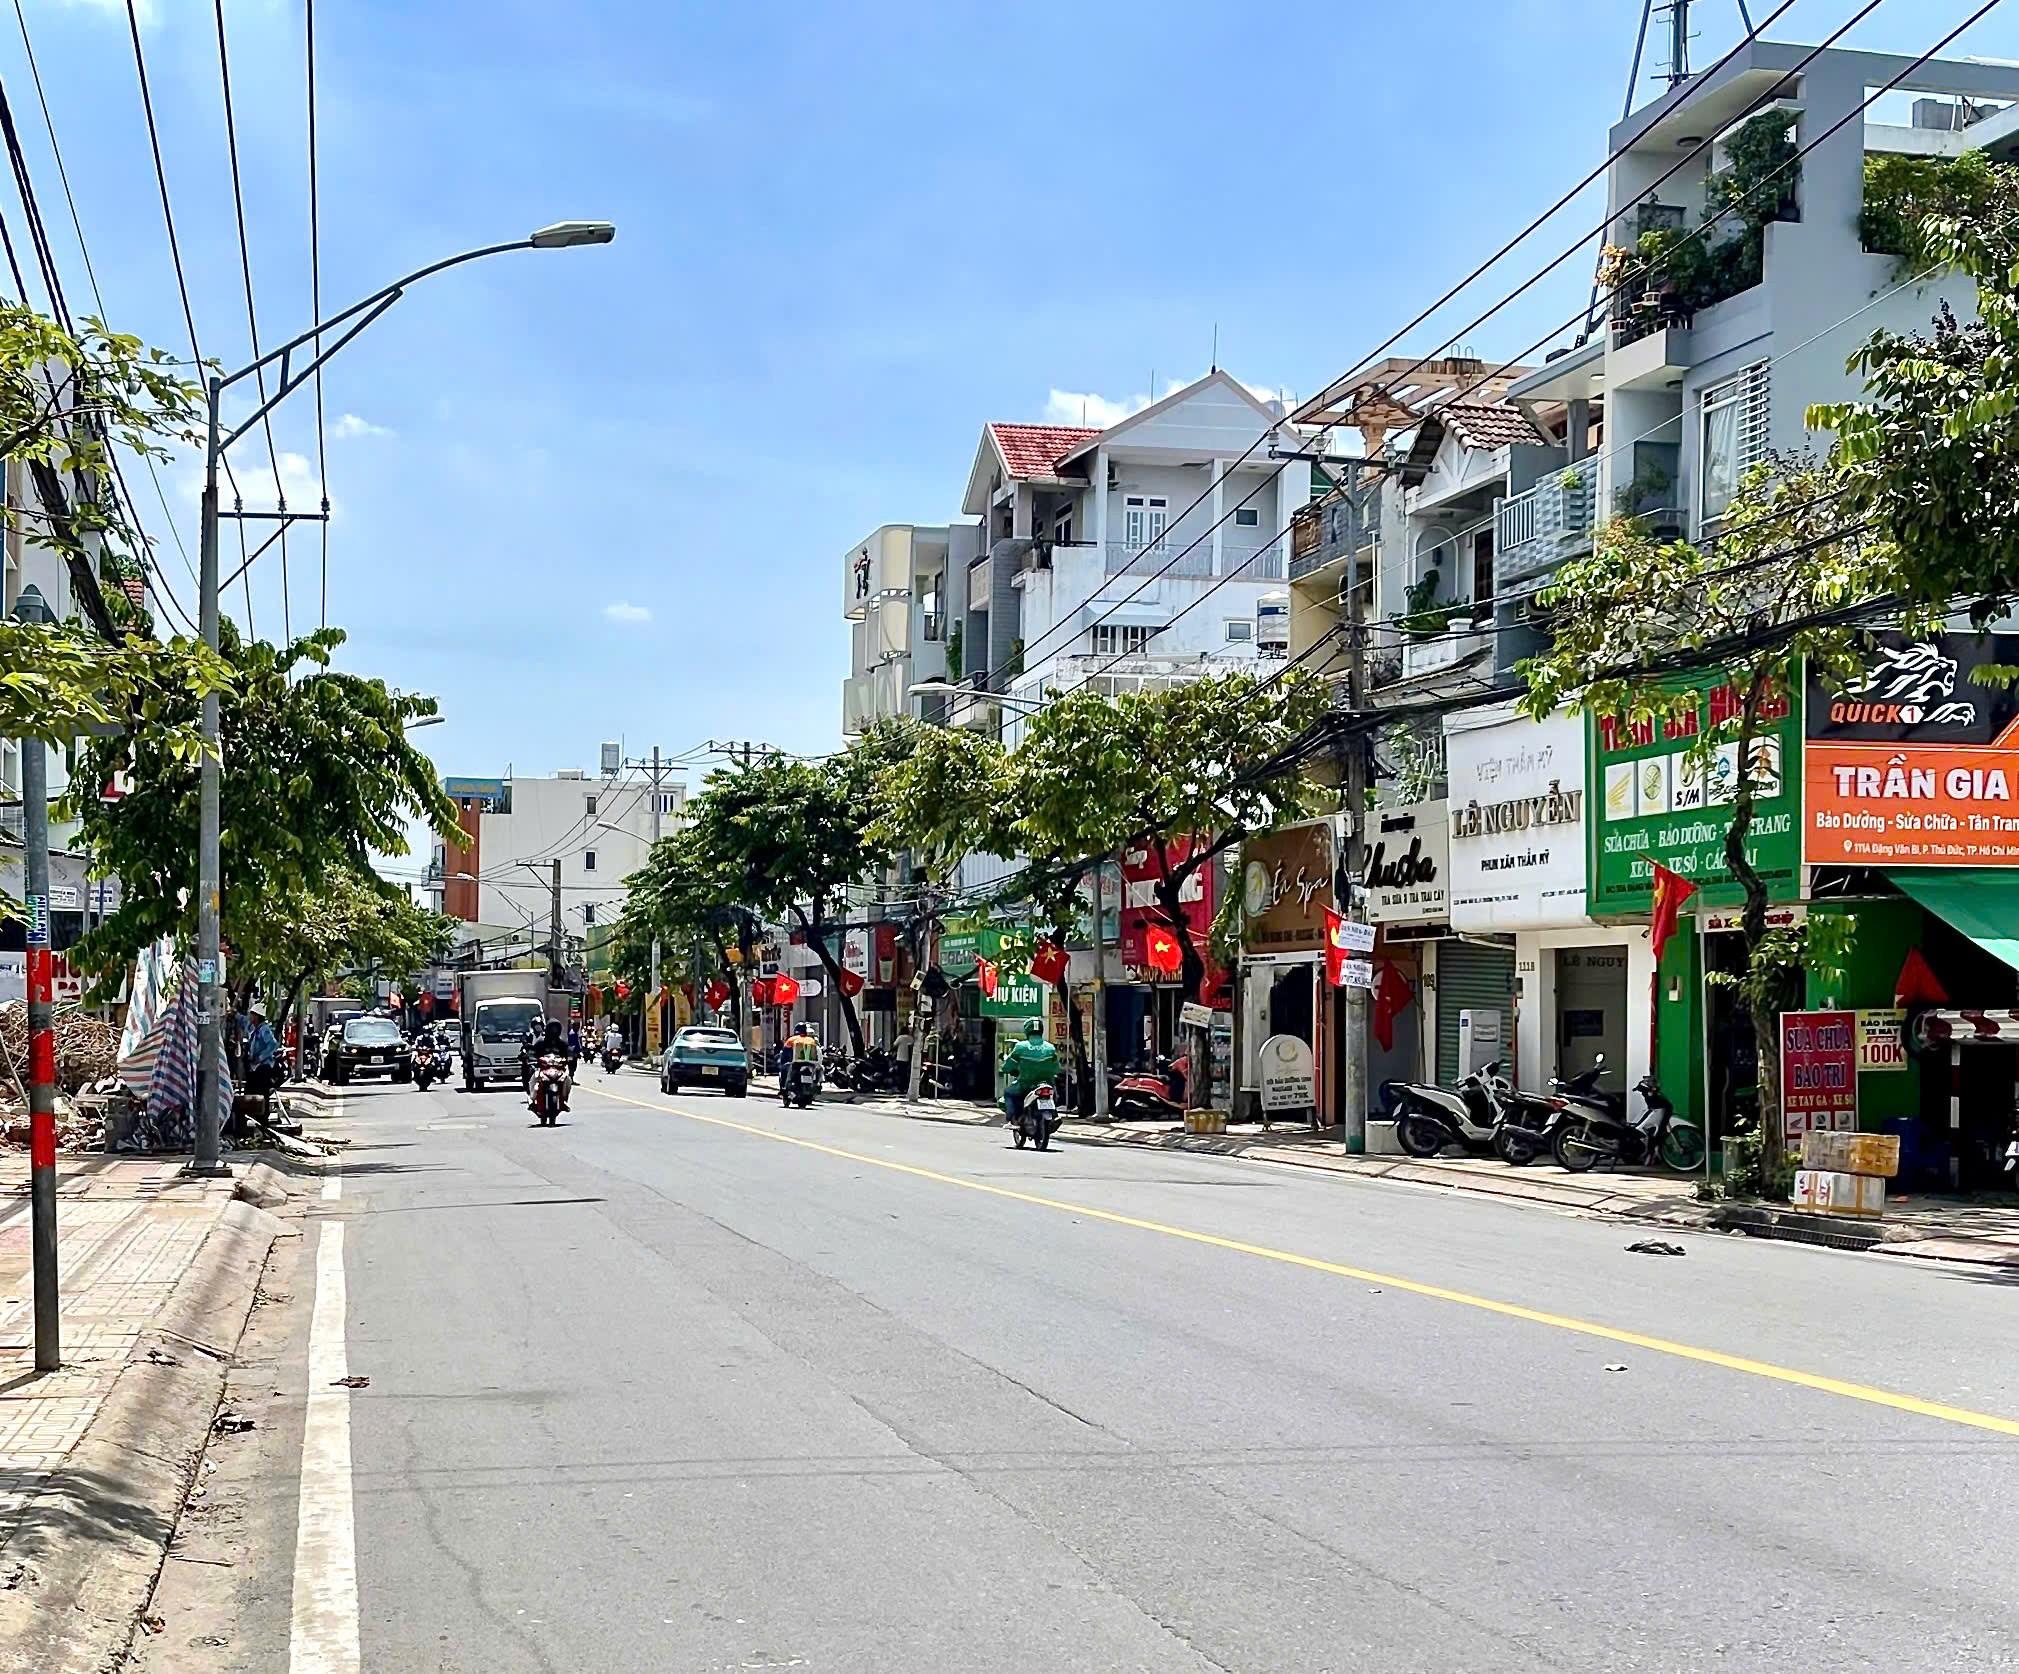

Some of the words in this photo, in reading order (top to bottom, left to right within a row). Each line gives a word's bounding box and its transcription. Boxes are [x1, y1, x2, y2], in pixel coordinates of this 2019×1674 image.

[1833, 753, 1936, 799] TRẦN
[1946, 768, 2010, 800] GIA
[1452, 800, 1482, 839] LÊ
[1816, 809, 1841, 828] Bảo
[1843, 809, 1885, 833] Dưỡng
[1895, 811, 1921, 830] Sửa
[1924, 813, 1958, 830] Chữa
[1968, 813, 1990, 831] Tân
[1604, 827, 1623, 853] SỬA
[1623, 828, 1650, 851] CHỮA
[1659, 822, 1680, 848] BẢO
[1680, 821, 1717, 844] DƯỠNG
[1630, 861, 1644, 878] XE
[1011, 984, 1038, 1007] KIỆN
[1787, 1017, 1814, 1053] SỬA
[1816, 1019, 1854, 1052] CHỮA
[1860, 1043, 1904, 1064] 100K
[1794, 1053, 1821, 1089] BẢO
